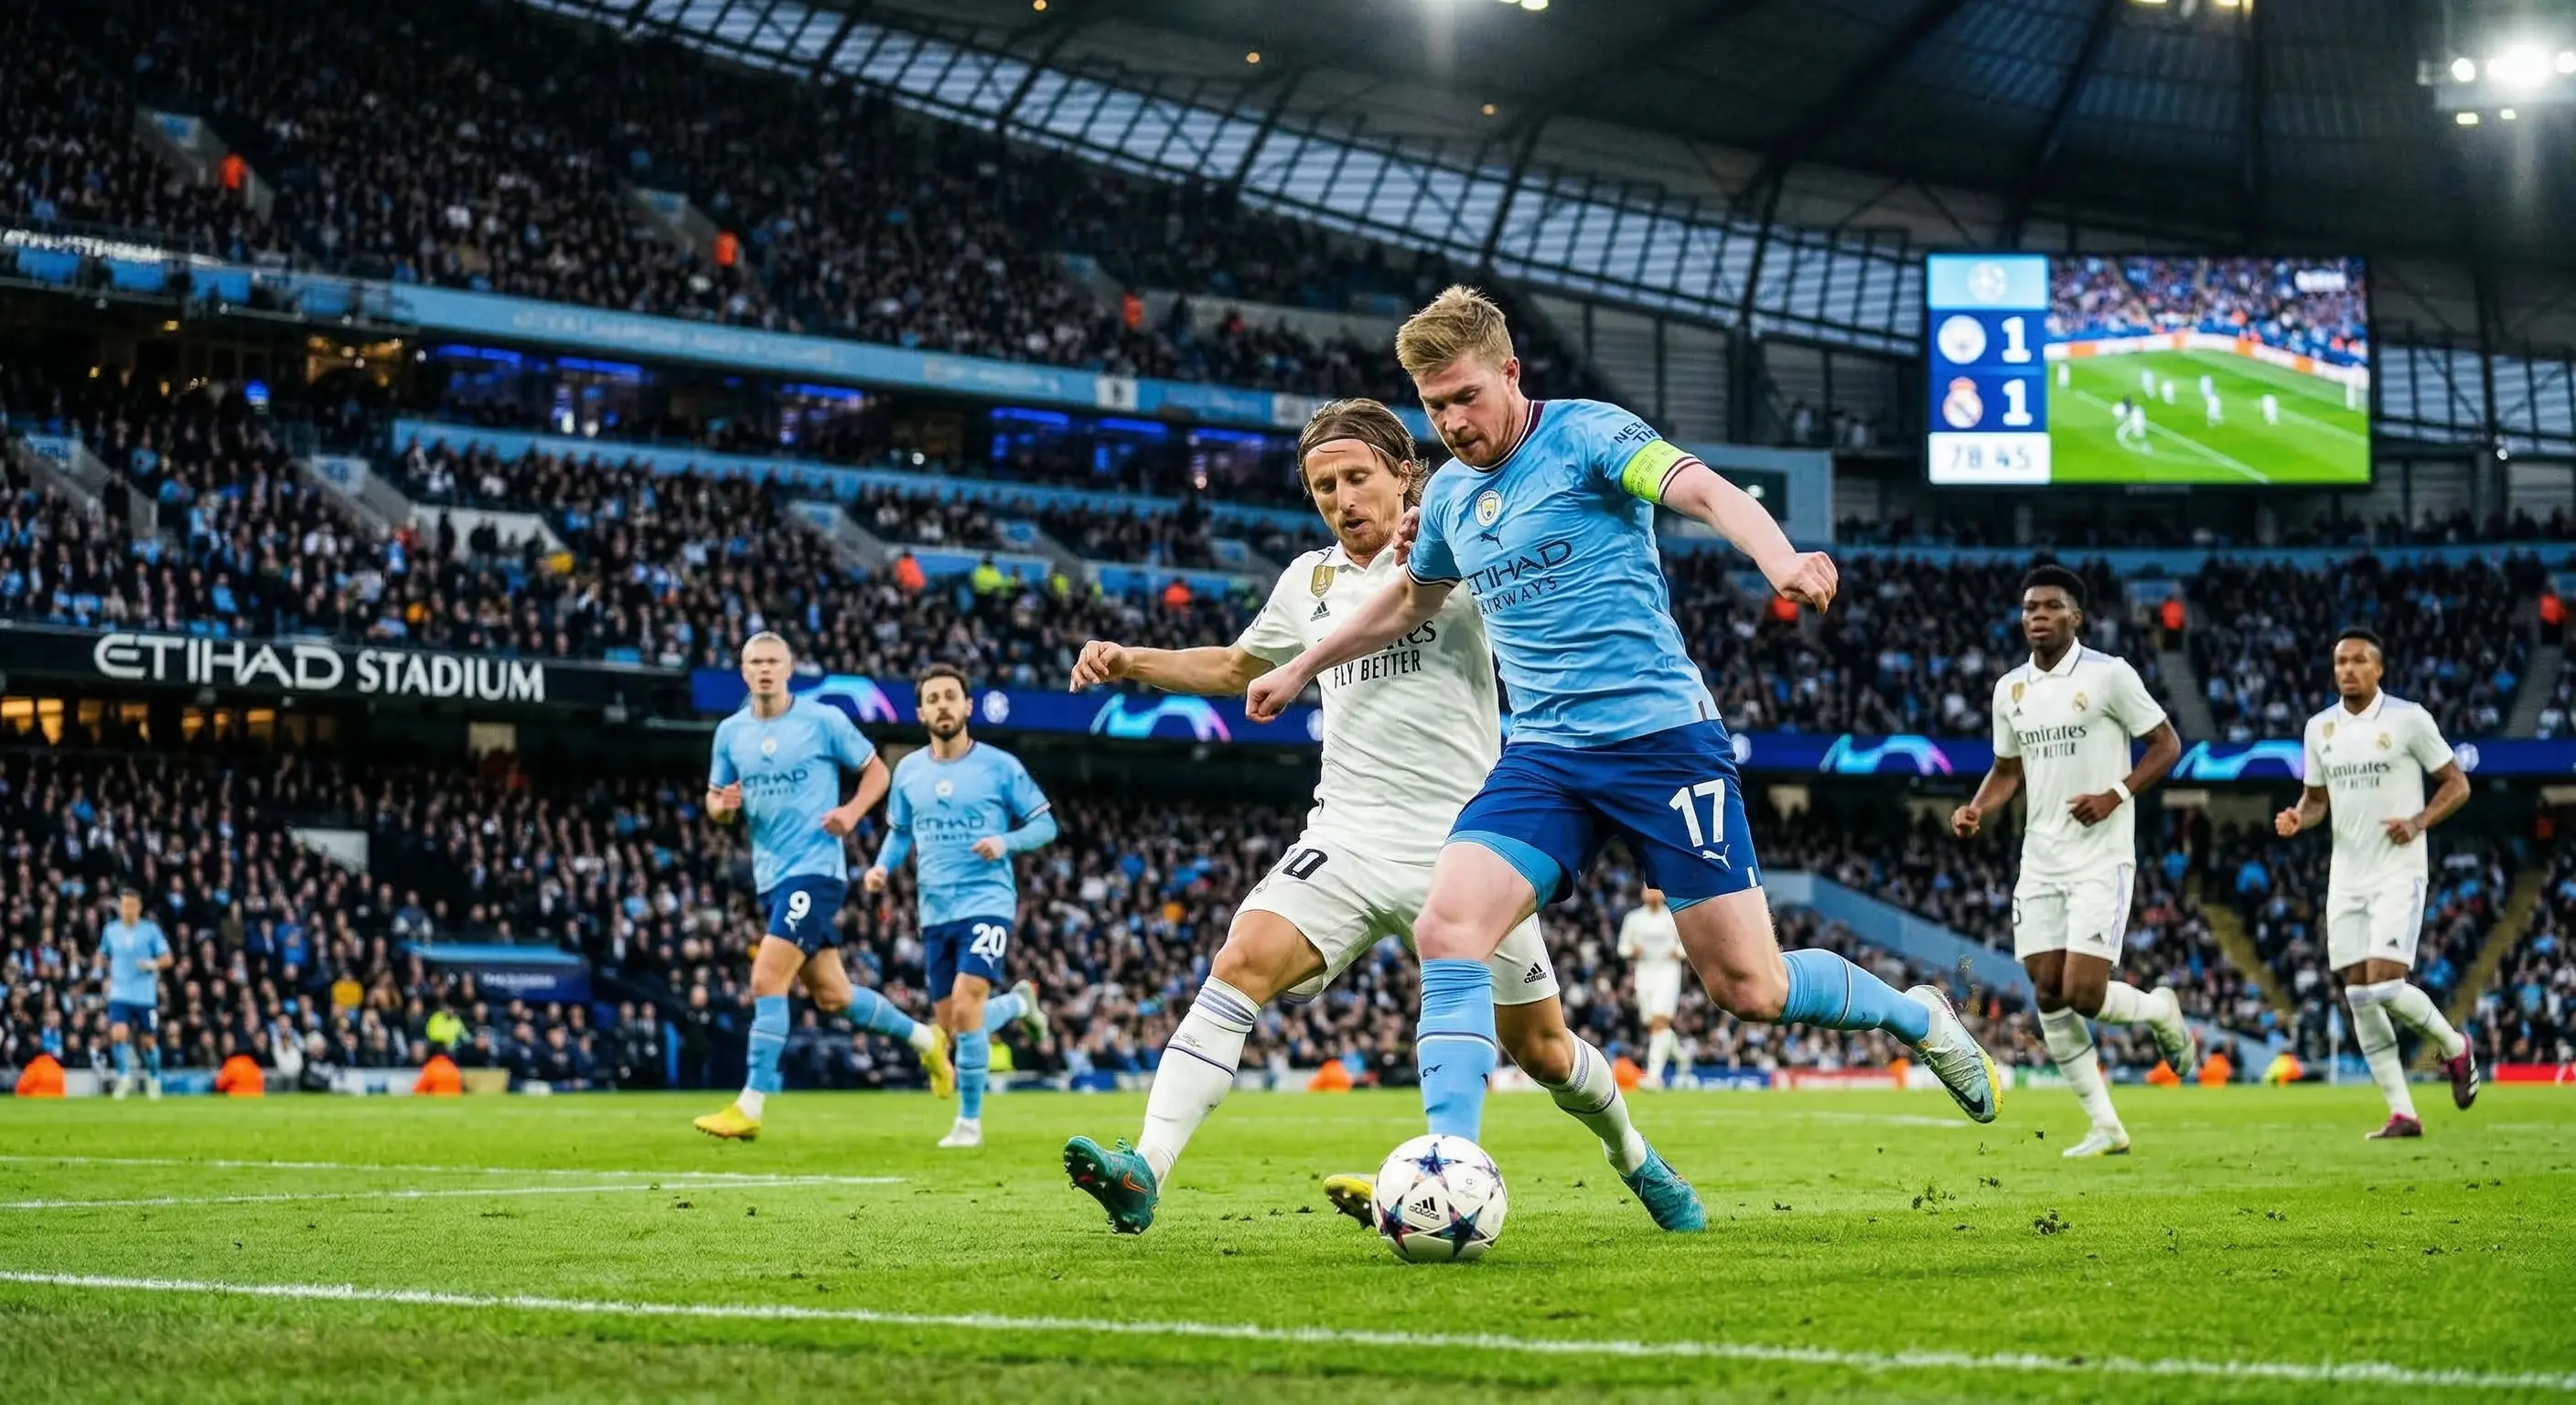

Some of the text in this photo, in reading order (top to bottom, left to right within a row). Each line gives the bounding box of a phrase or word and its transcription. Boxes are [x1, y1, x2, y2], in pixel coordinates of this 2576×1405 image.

[2002, 316, 2032, 363] 1
[2002, 379, 2033, 426] 1
[1467, 540, 1572, 596] TIHAD
[1481, 575, 1557, 615] AIRWAYS
[93, 633, 545, 702] ETIHAD STADIUM
[1334, 649, 1422, 690] FLY BETTER
[2016, 724, 2087, 745] Emirates
[1669, 778, 1725, 848] 17
[789, 890, 812, 921] 9
[970, 923, 1007, 959] 20
